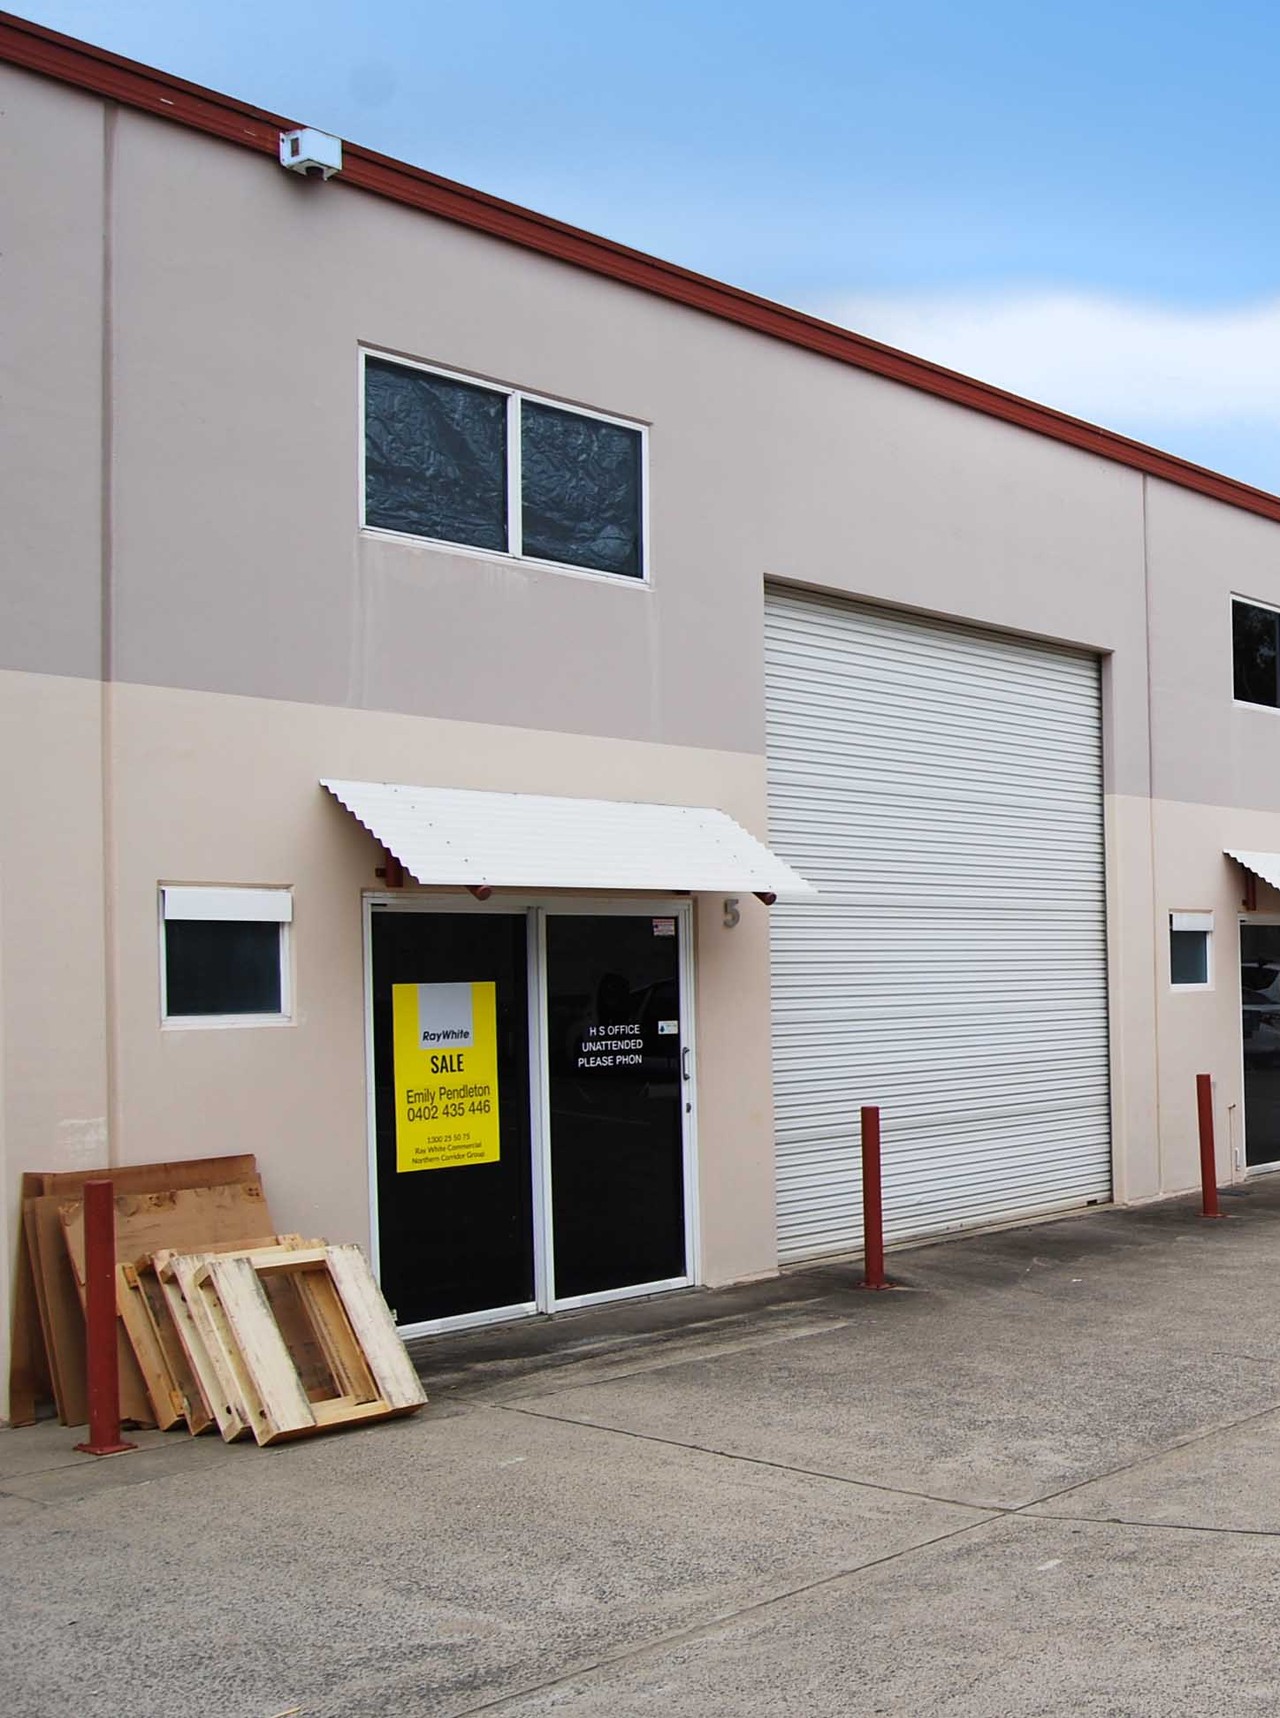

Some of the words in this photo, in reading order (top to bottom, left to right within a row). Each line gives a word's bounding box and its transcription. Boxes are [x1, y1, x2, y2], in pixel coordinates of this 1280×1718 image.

[723, 898, 740, 929] 5
[422, 1029, 470, 1042] RayWhite
[607, 1024, 641, 1036] OFFICE
[582, 1039, 643, 1052] UNATTENDED
[430, 1053, 465, 1074] SALE
[578, 1056, 614, 1067] PLEASE
[616, 1054, 643, 1065] PHON
[406, 1089, 436, 1105] Emily
[438, 1084, 491, 1101] Pendleton
[407, 1105, 439, 1122] 0402
[442, 1102, 465, 1118] 435
[468, 1099, 491, 1115] 446
[428, 1145, 446, 1153] White
